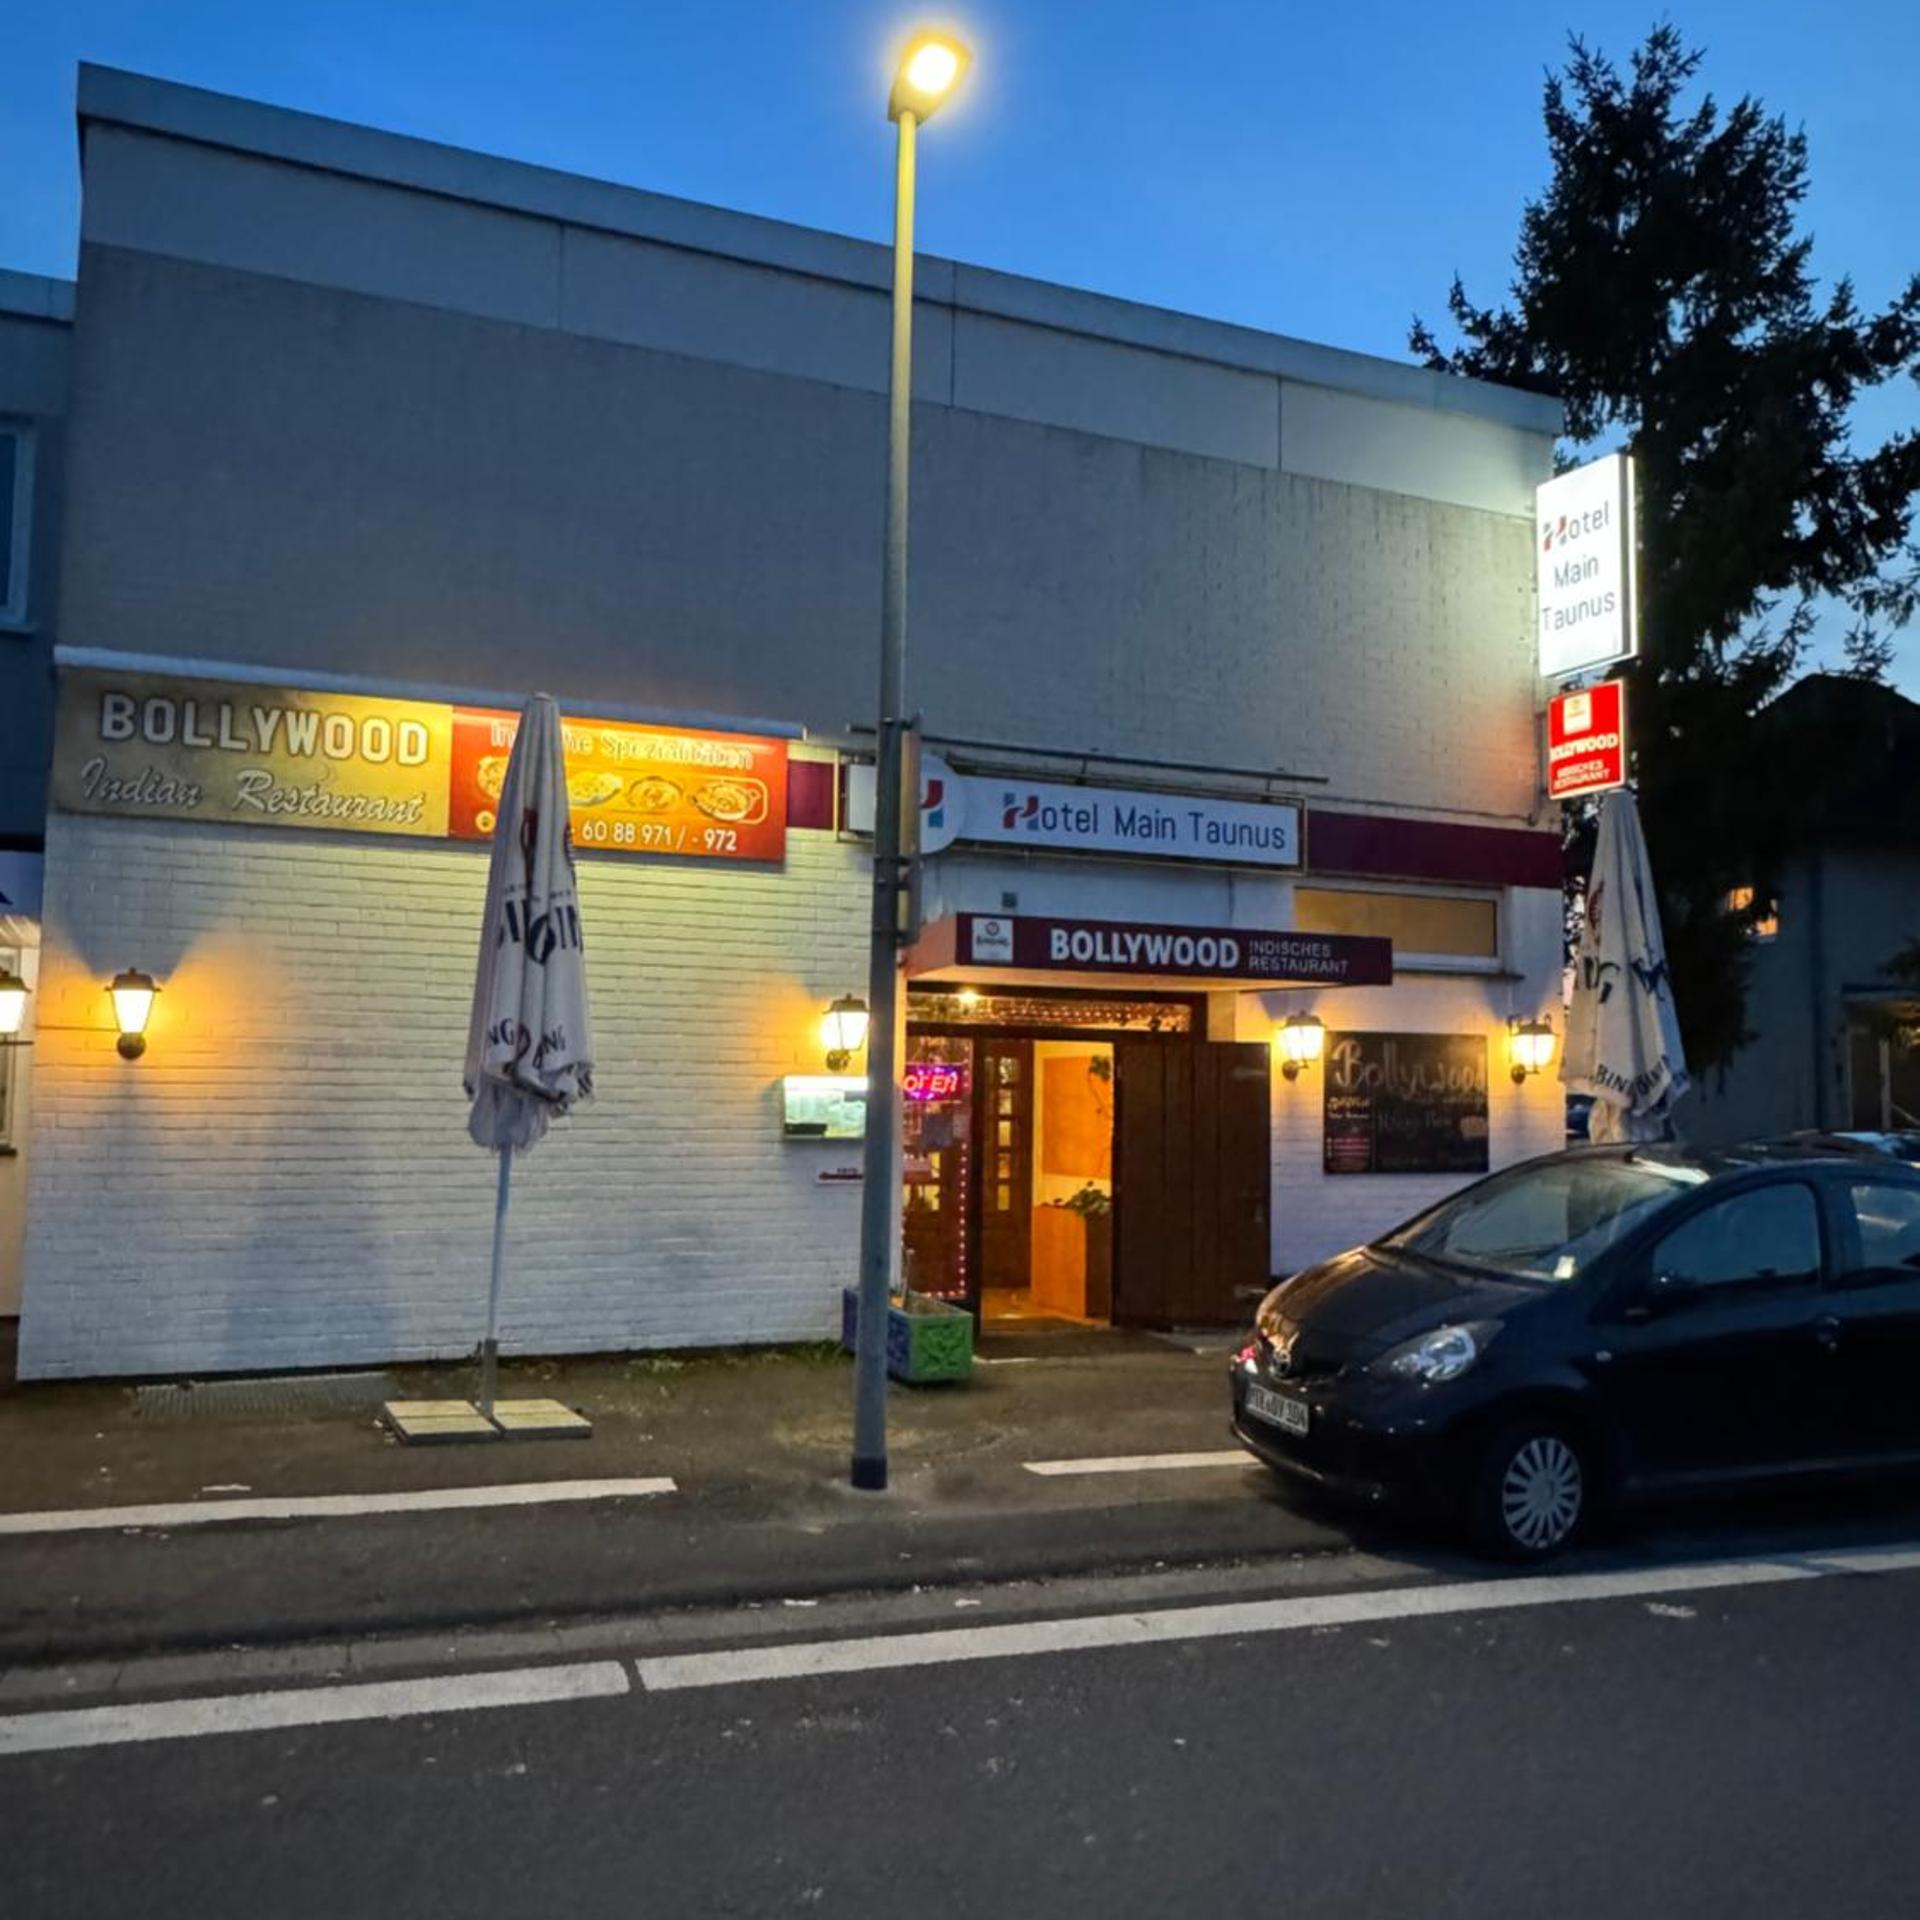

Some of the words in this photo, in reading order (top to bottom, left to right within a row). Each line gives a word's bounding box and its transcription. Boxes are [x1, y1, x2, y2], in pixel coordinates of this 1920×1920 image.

[1543, 500, 1609, 551] Hotel
[1554, 555, 1599, 589] Main
[1541, 591, 1616, 631] Taunus
[101, 693, 430, 766] BOLLYWOOD
[80, 758, 202, 807] Indian
[232, 770, 426, 824] Restaurant
[582, 819, 608, 842] 60
[613, 822, 636, 844] 88
[1003, 793, 1099, 834] Hotel
[1114, 806, 1177, 841] Main
[1188, 811, 1286, 850] Taunus
[1050, 928, 1240, 969] BOLLYWOOD
[1248, 939, 1331, 958] INDISCHES
[1248, 955, 1349, 974] RESTAURANT
